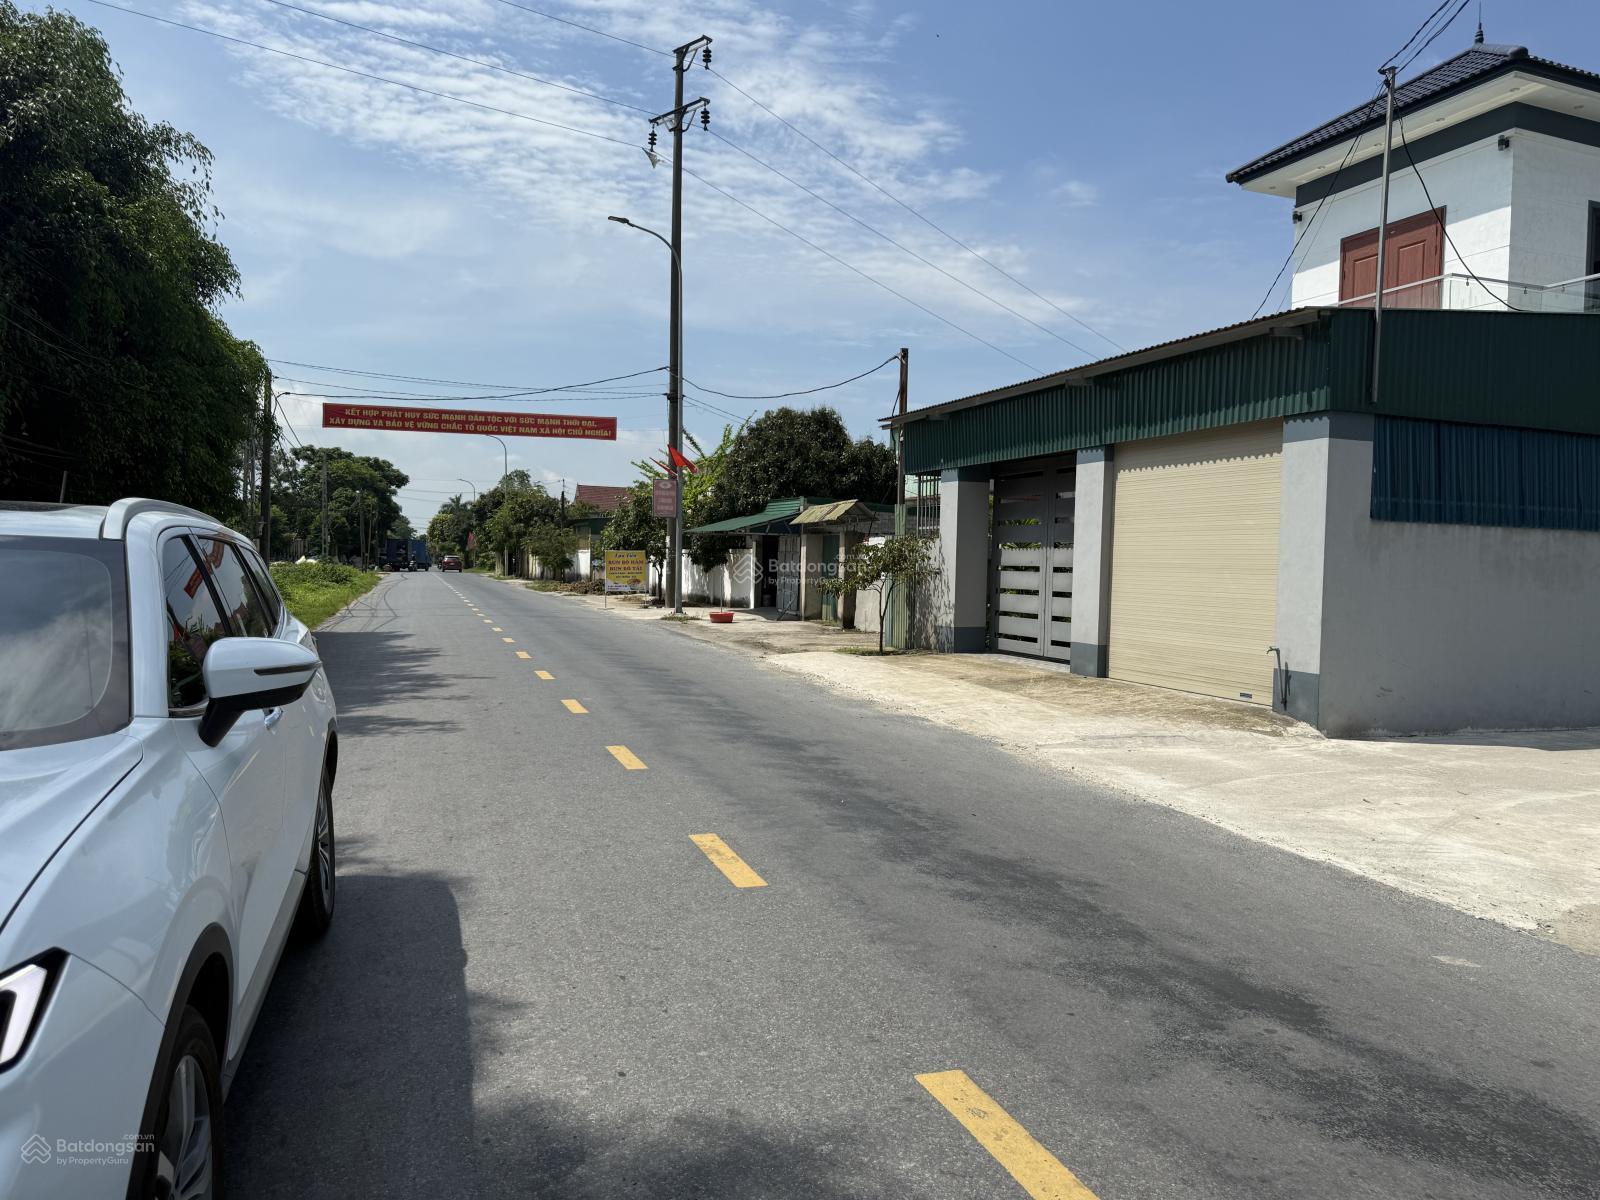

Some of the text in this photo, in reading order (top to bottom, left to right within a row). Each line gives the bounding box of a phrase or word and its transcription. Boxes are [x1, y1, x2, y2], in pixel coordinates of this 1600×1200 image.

[329, 416, 346, 425] XÂY
[347, 418, 371, 427] DỰNG
[372, 419, 384, 427] VÀ
[404, 420, 415, 429] VỆ
[476, 423, 499, 432] QUỐC
[500, 425, 517, 434] VIỆT
[519, 426, 538, 434] NAM
[552, 428, 566, 436] HỘI
[345, 408, 361, 416] KẾT
[363, 409, 380, 418] HỢP
[381, 410, 402, 418] PHÁT
[405, 411, 421, 419] HUY
[423, 411, 440, 420] SỨC
[441, 413, 466, 421] MẠNH
[468, 414, 485, 422] DÂN
[487, 415, 503, 423] TỘC
[504, 416, 518, 424] VỚI
[519, 416, 535, 424] SỨC
[537, 418, 561, 426] MẠNH
